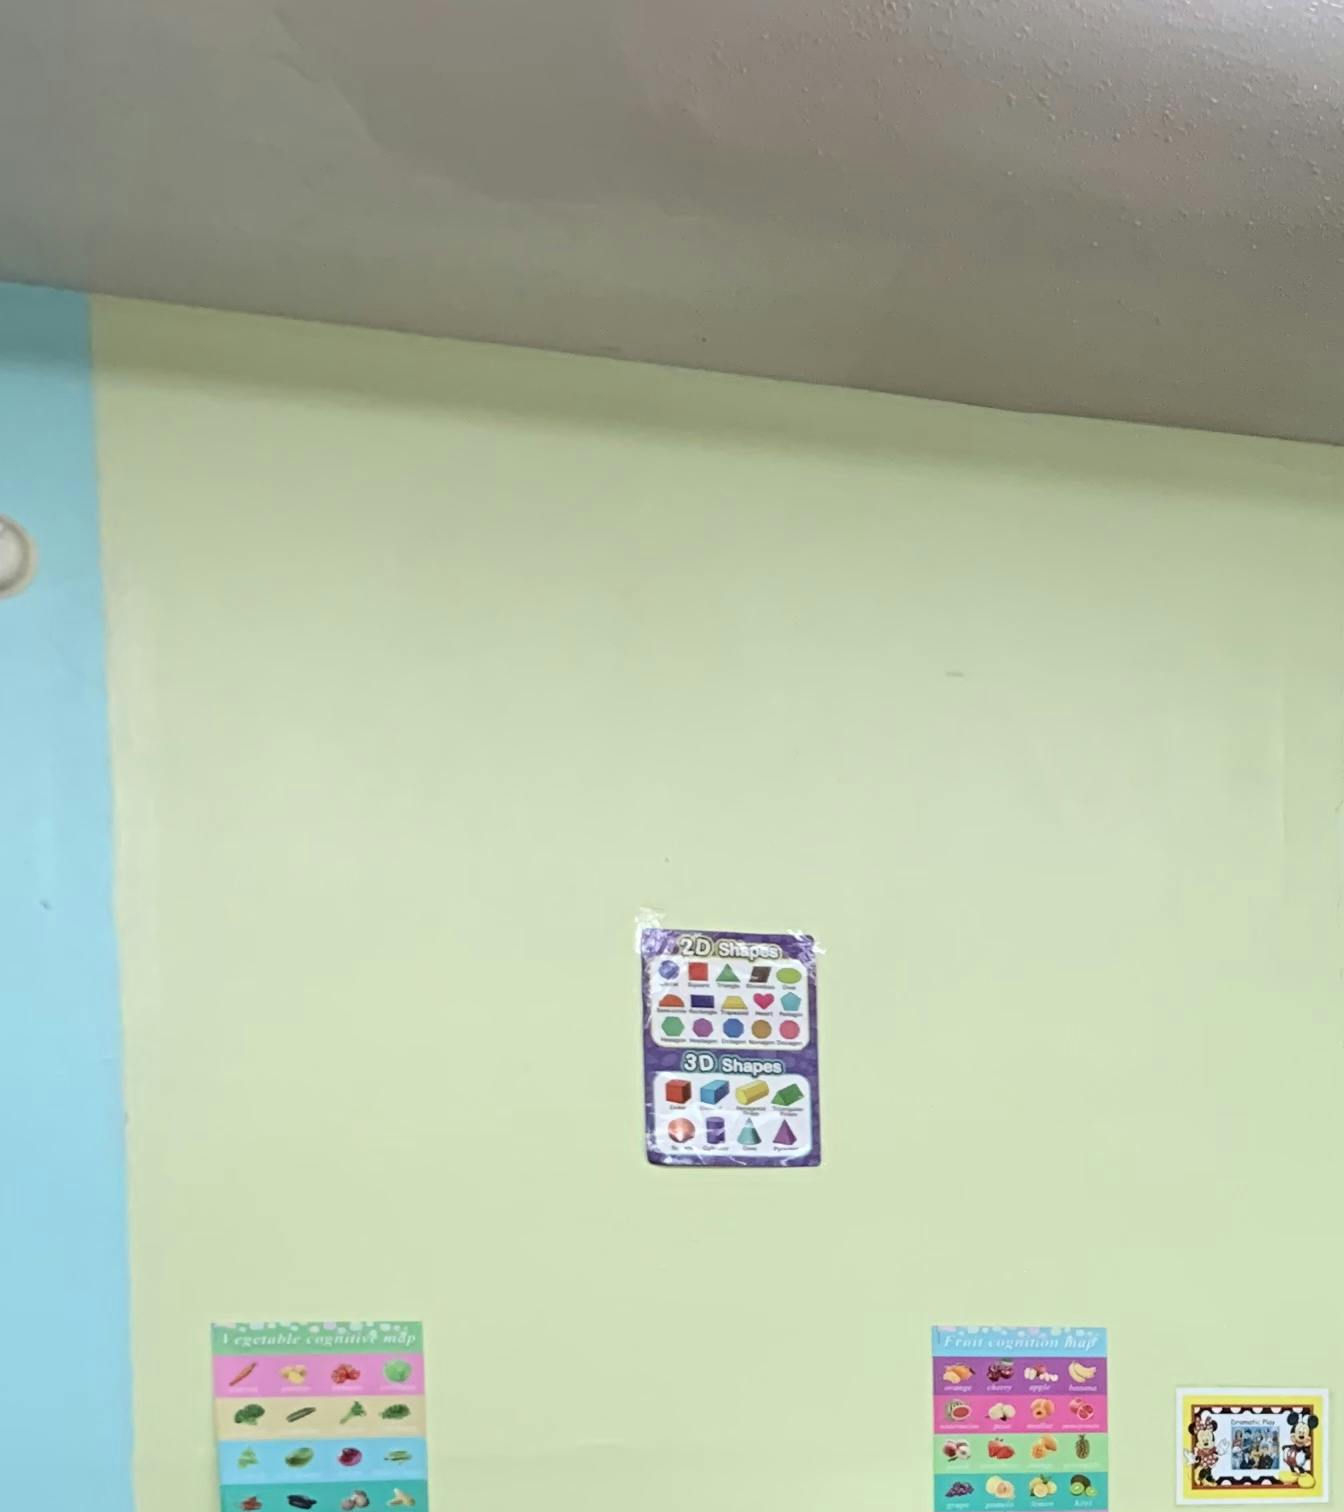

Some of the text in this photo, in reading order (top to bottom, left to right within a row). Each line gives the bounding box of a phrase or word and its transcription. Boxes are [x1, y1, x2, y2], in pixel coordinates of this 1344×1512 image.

[679, 937, 779, 961] 2D Shapes
[684, 1053, 782, 1077] 3D Shapes
[306, 1332, 378, 1347] cognitive
[383, 1333, 416, 1347] map
[944, 1335, 1098, 1351] Fruit cognition map
